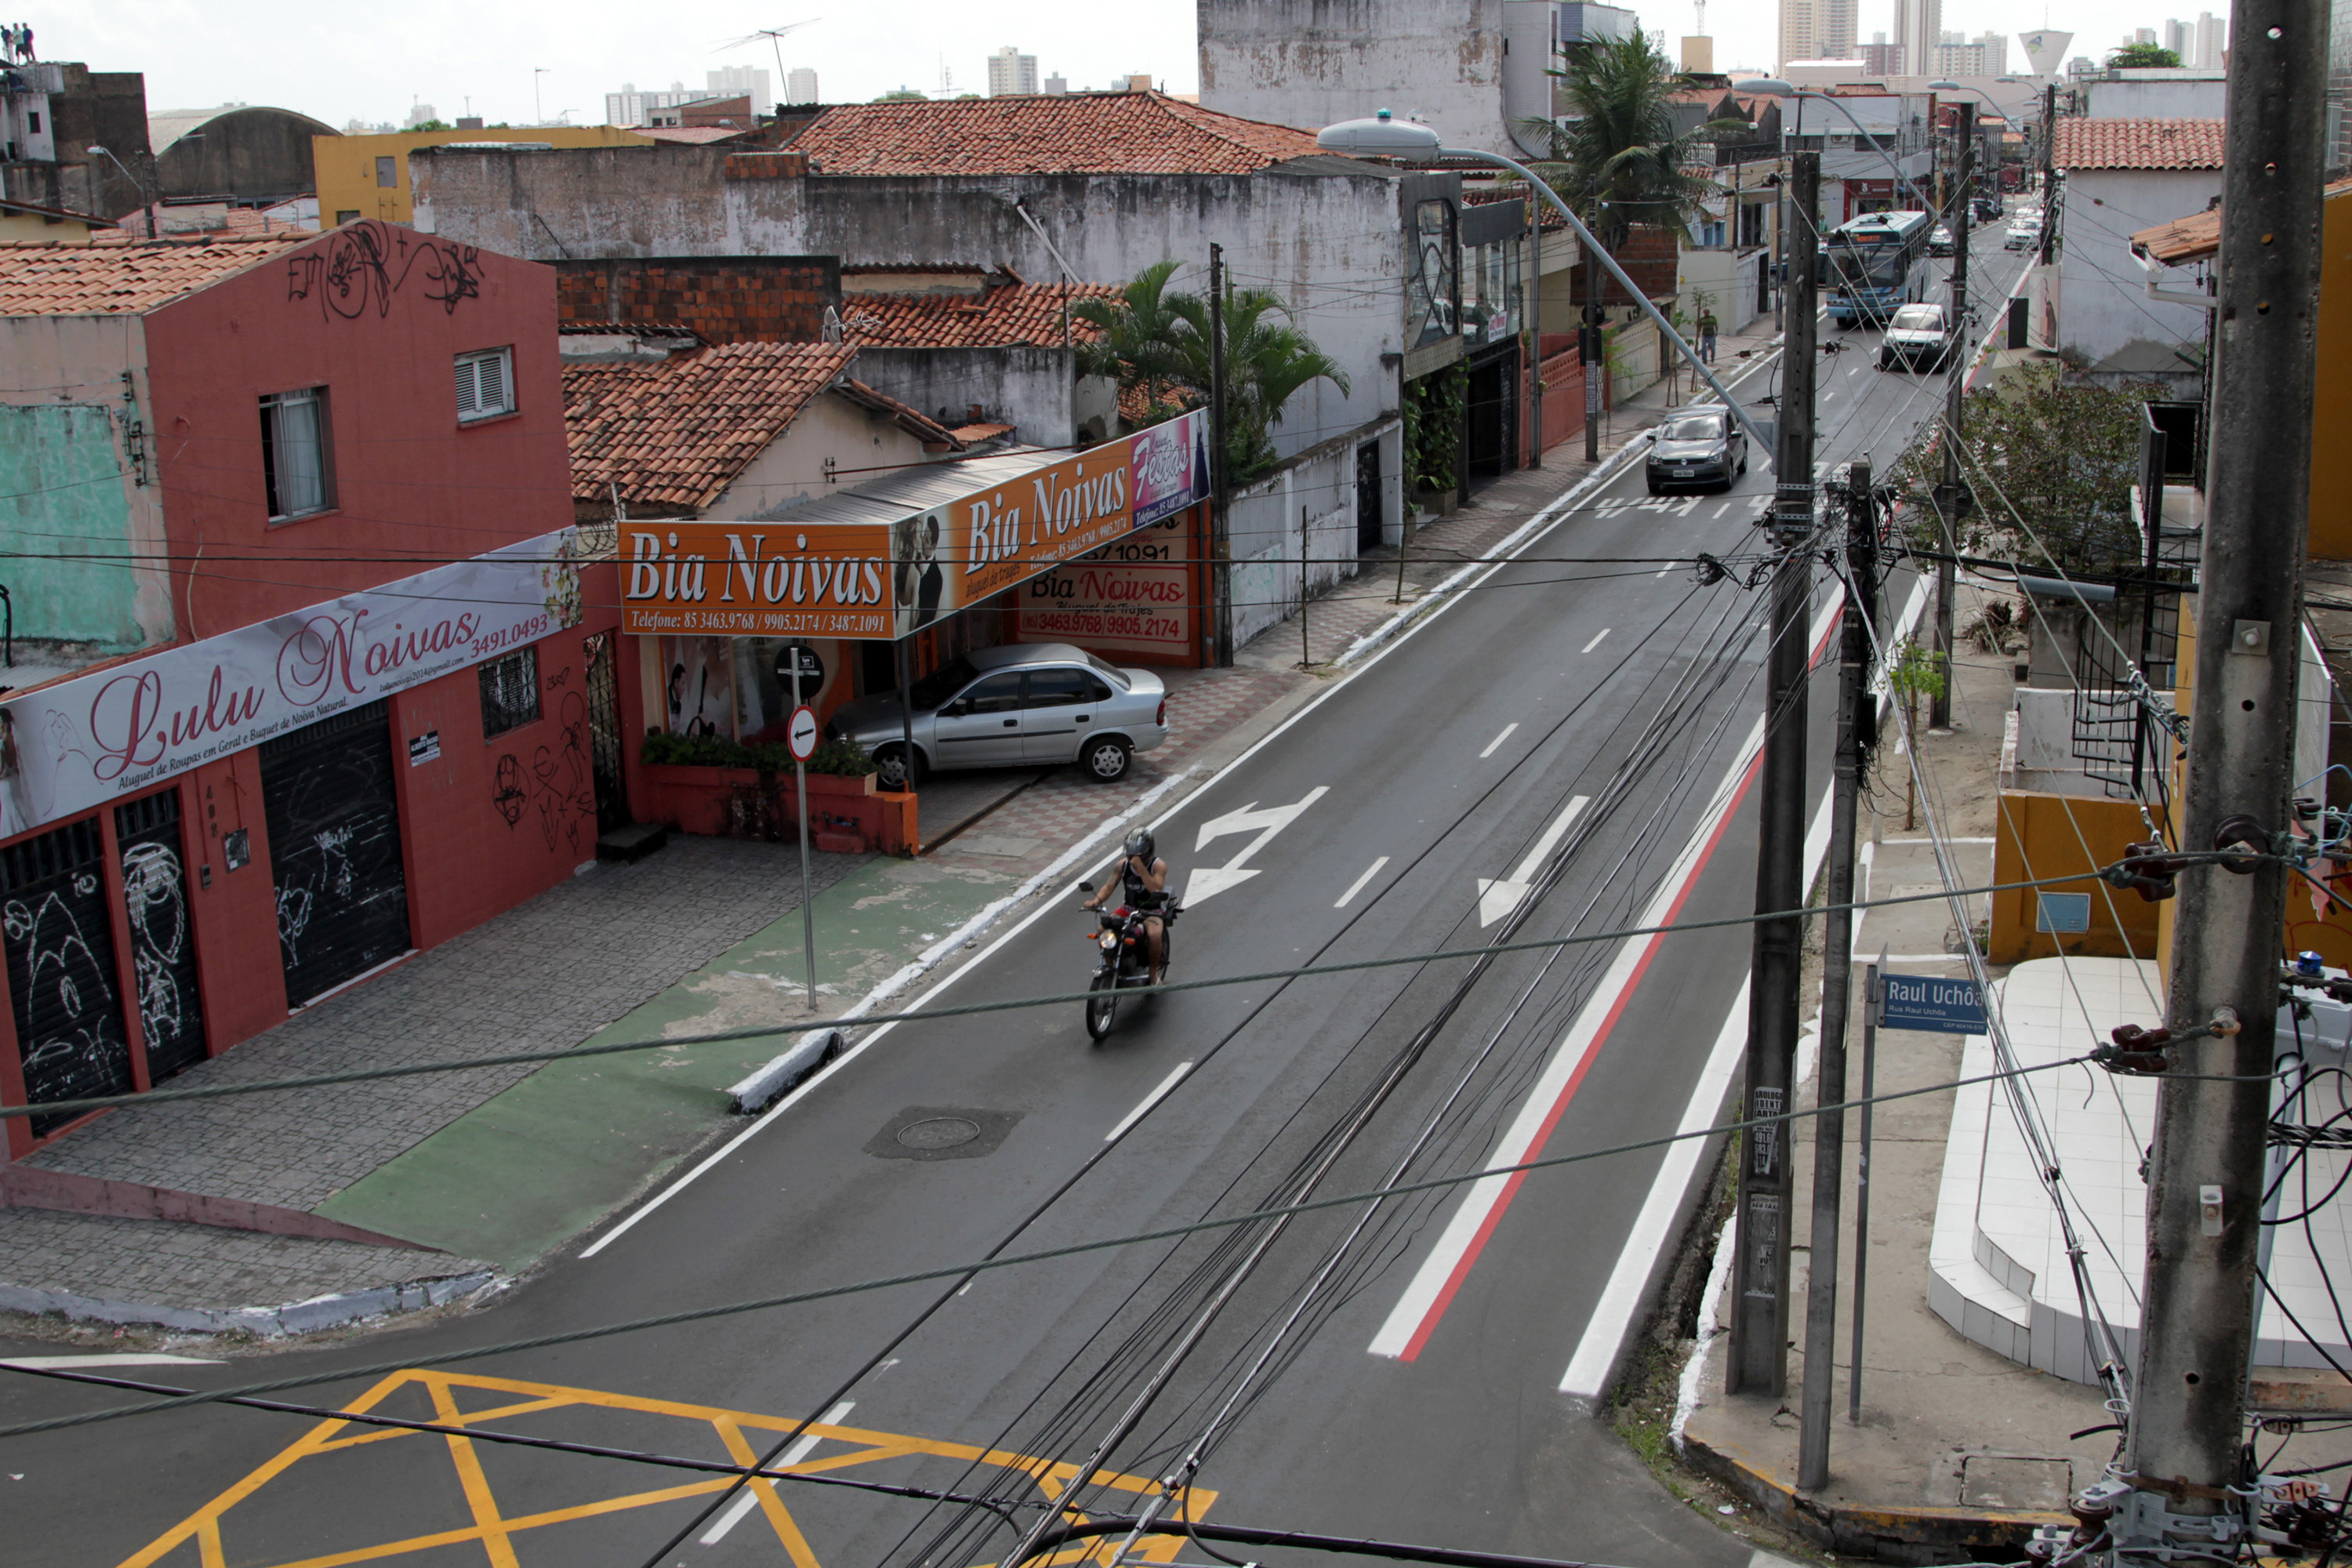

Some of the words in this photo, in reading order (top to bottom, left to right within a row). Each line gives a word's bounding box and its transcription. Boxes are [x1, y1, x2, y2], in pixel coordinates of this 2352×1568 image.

[1133, 435, 1189, 501] Festas
[965, 492, 1021, 575] Bia
[1029, 463, 1126, 546] Noivas
[626, 532, 707, 603] Bia
[720, 533, 884, 605] Noivas
[1032, 570, 1075, 598] Bia
[1080, 571, 1185, 603] Noivas
[631, 611, 681, 630] Telefone:
[684, 612, 696, 628] 85
[700, 612, 754, 630] 3463.9768
[764, 613, 819, 631] 9905.2174
[829, 615, 884, 632] 3487.1091
[1056, 601, 1098, 615] Aluguel
[470, 614, 548, 659] 3491.0493
[90, 665, 264, 780] Lulu
[277, 608, 481, 706] Noivas
[118, 766, 154, 790] Aluguel
[157, 763, 167, 776] de
[169, 754, 201, 772] Roupas
[204, 748, 216, 759] em
[219, 735, 241, 752] Geral
[243, 735, 249, 744] e
[250, 723, 278, 742] Buquet
[281, 718, 290, 730] de
[292, 709, 315, 725] Noiva
[1889, 982, 1926, 1003] Raul
[1923, 1007, 1946, 1016] Uchôa
